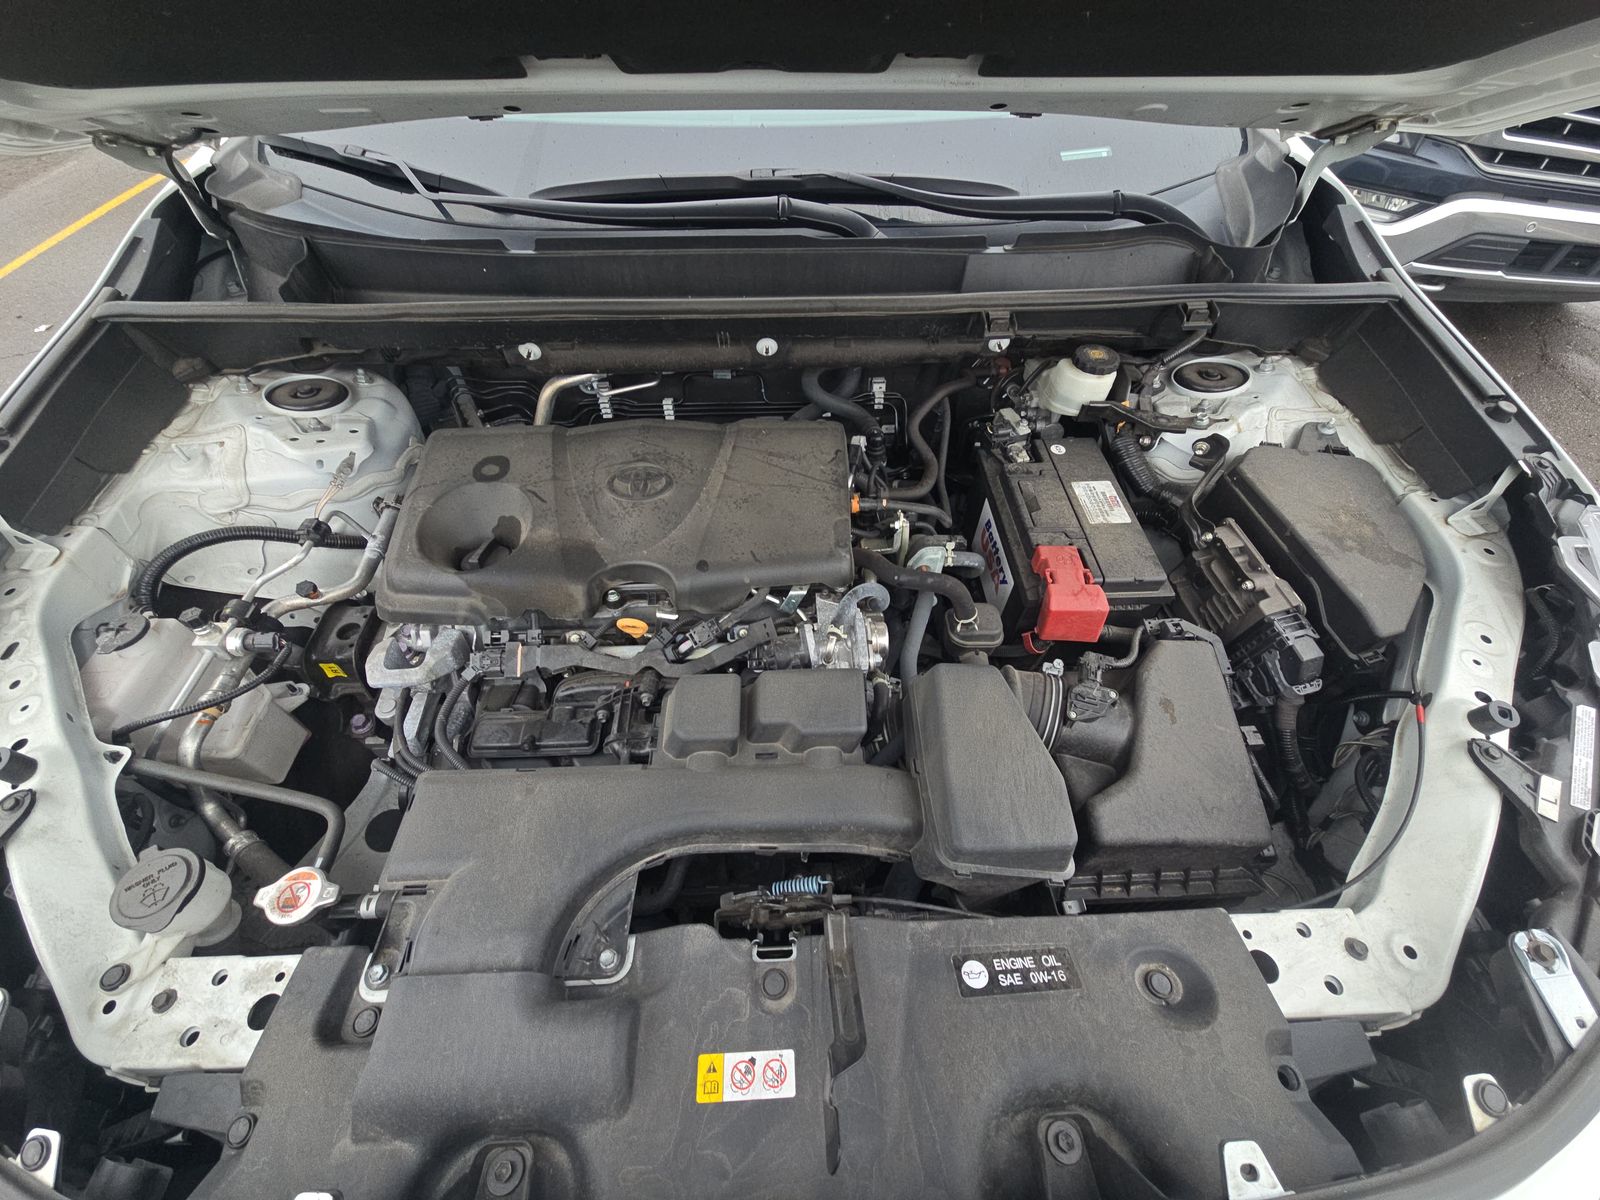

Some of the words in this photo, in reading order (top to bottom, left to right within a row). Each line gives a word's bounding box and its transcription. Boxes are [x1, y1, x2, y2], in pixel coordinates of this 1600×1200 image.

[985, 518, 1008, 585] Battery
[992, 956, 1036, 971] ENGINE
[1041, 954, 1062, 967] OIL
[997, 973, 1023, 987] SAE
[1029, 969, 1067, 984] 0W-16
